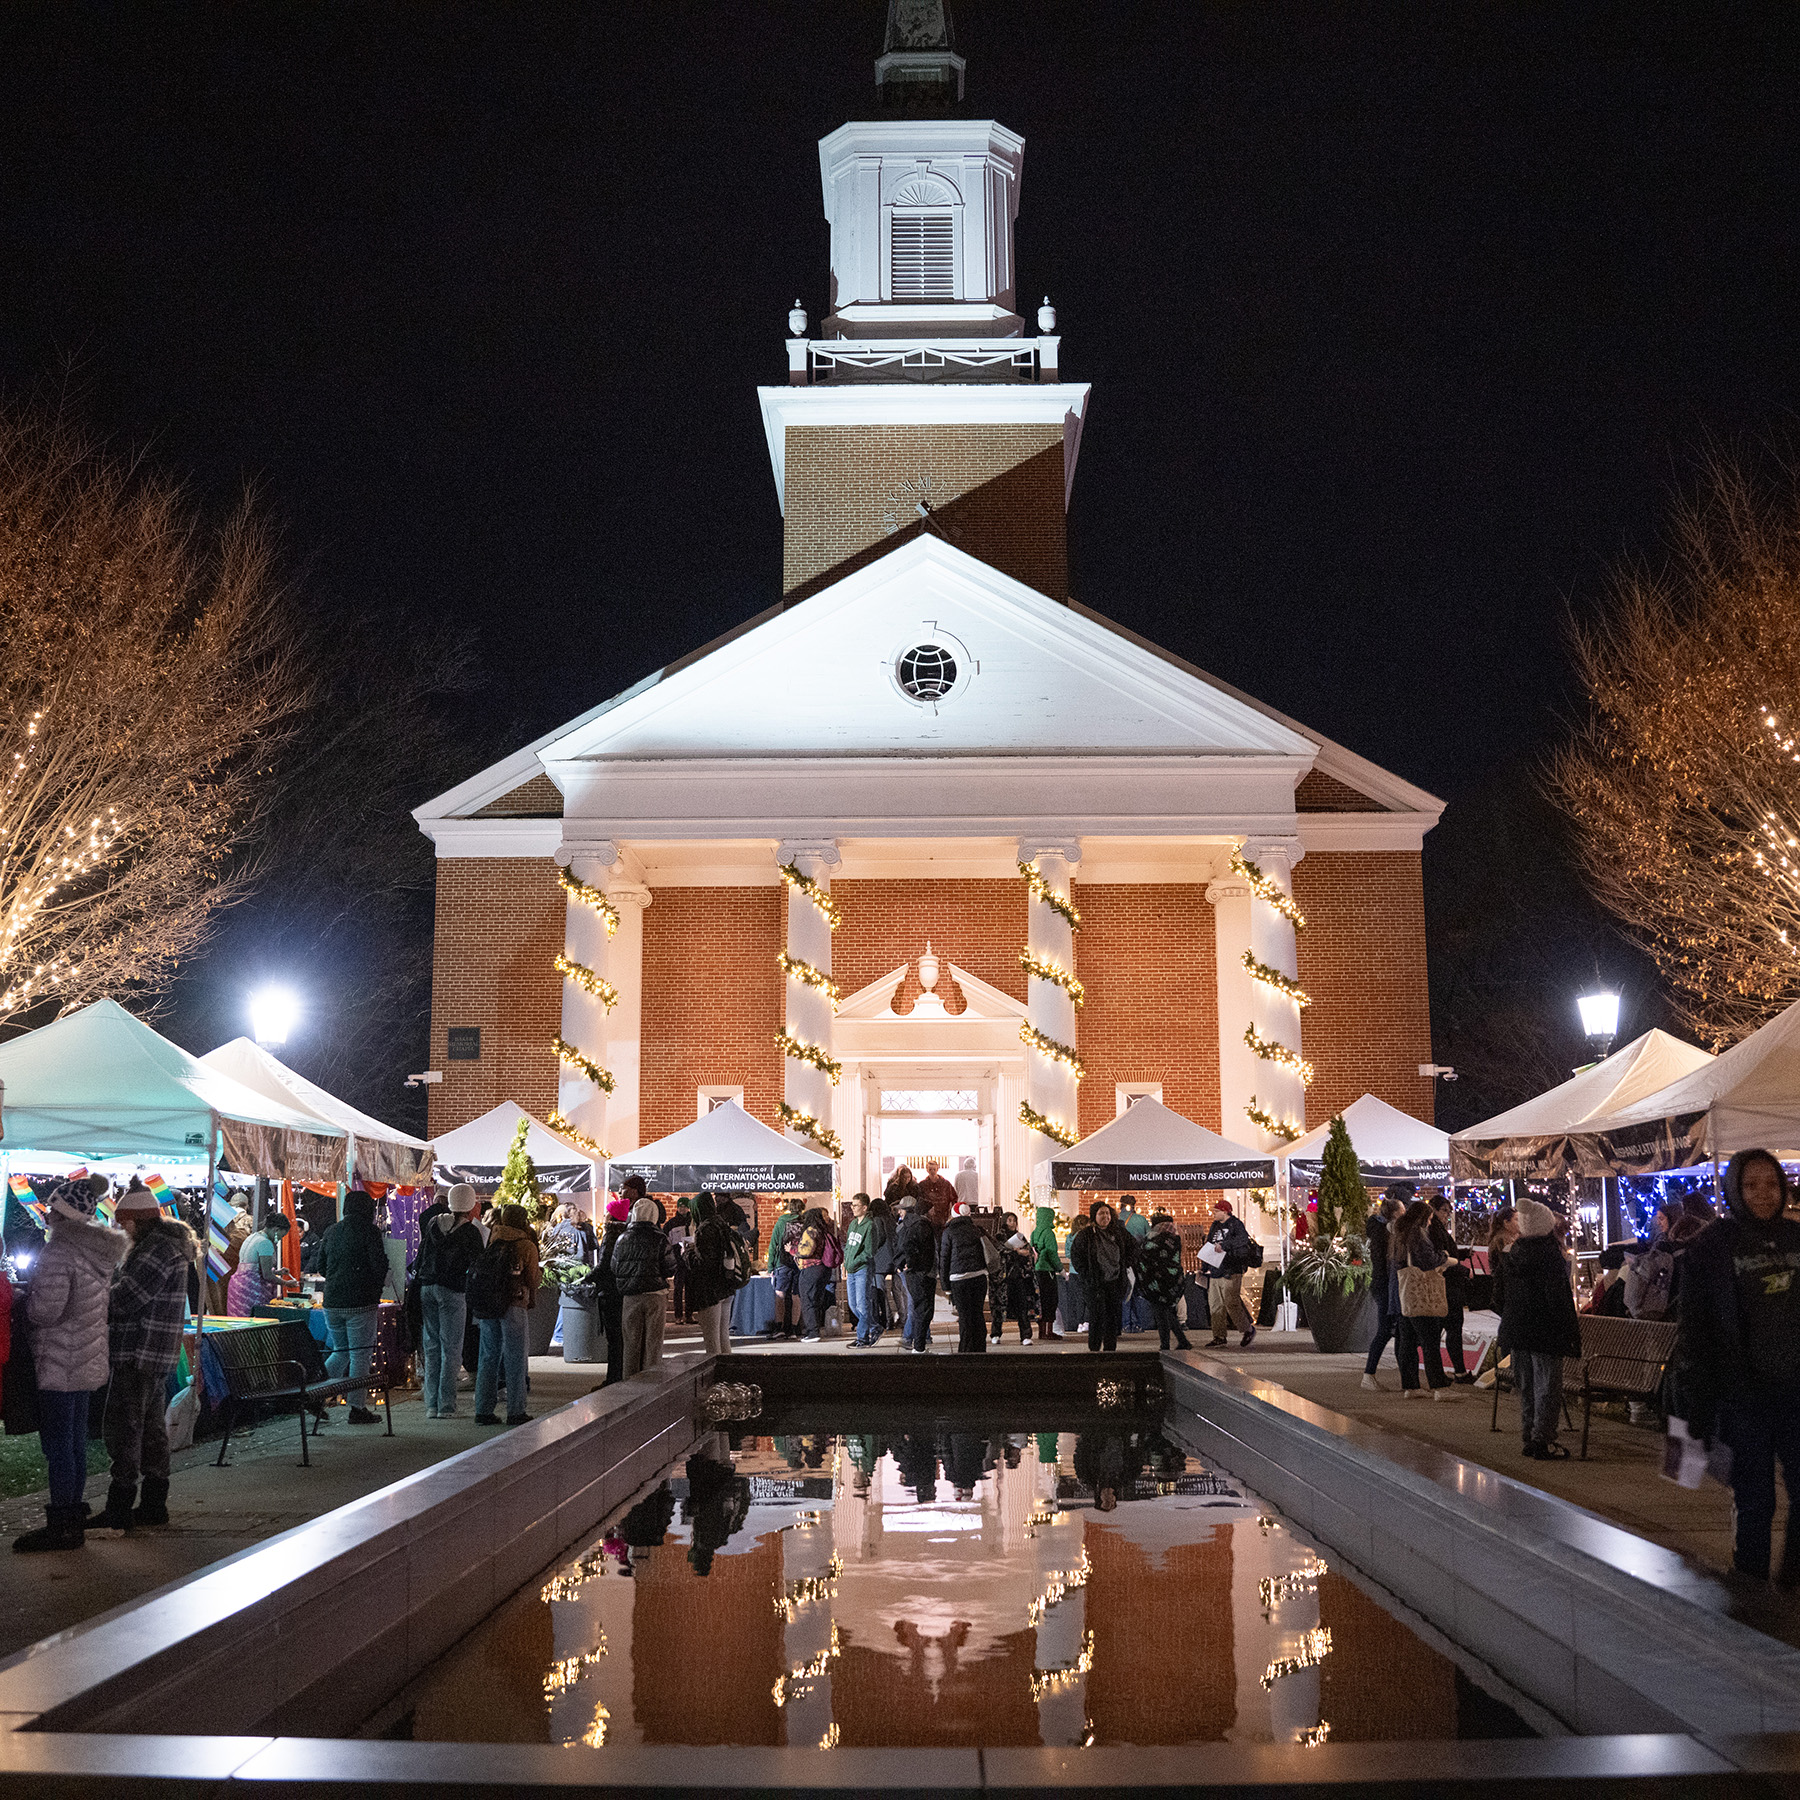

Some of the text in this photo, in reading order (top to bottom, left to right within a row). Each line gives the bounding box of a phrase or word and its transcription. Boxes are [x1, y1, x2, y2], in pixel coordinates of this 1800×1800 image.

[464, 1175, 494, 1184] LEVELS
[710, 1173, 796, 1181] INTERNATIONAL AND
[1129, 1170, 1265, 1181] MUSLIM STUDENTS ASSOCIATION
[1418, 1172, 1448, 1180] NAACP
[701, 1182, 805, 1190] OFF-CAMPUS PROGRAMS
